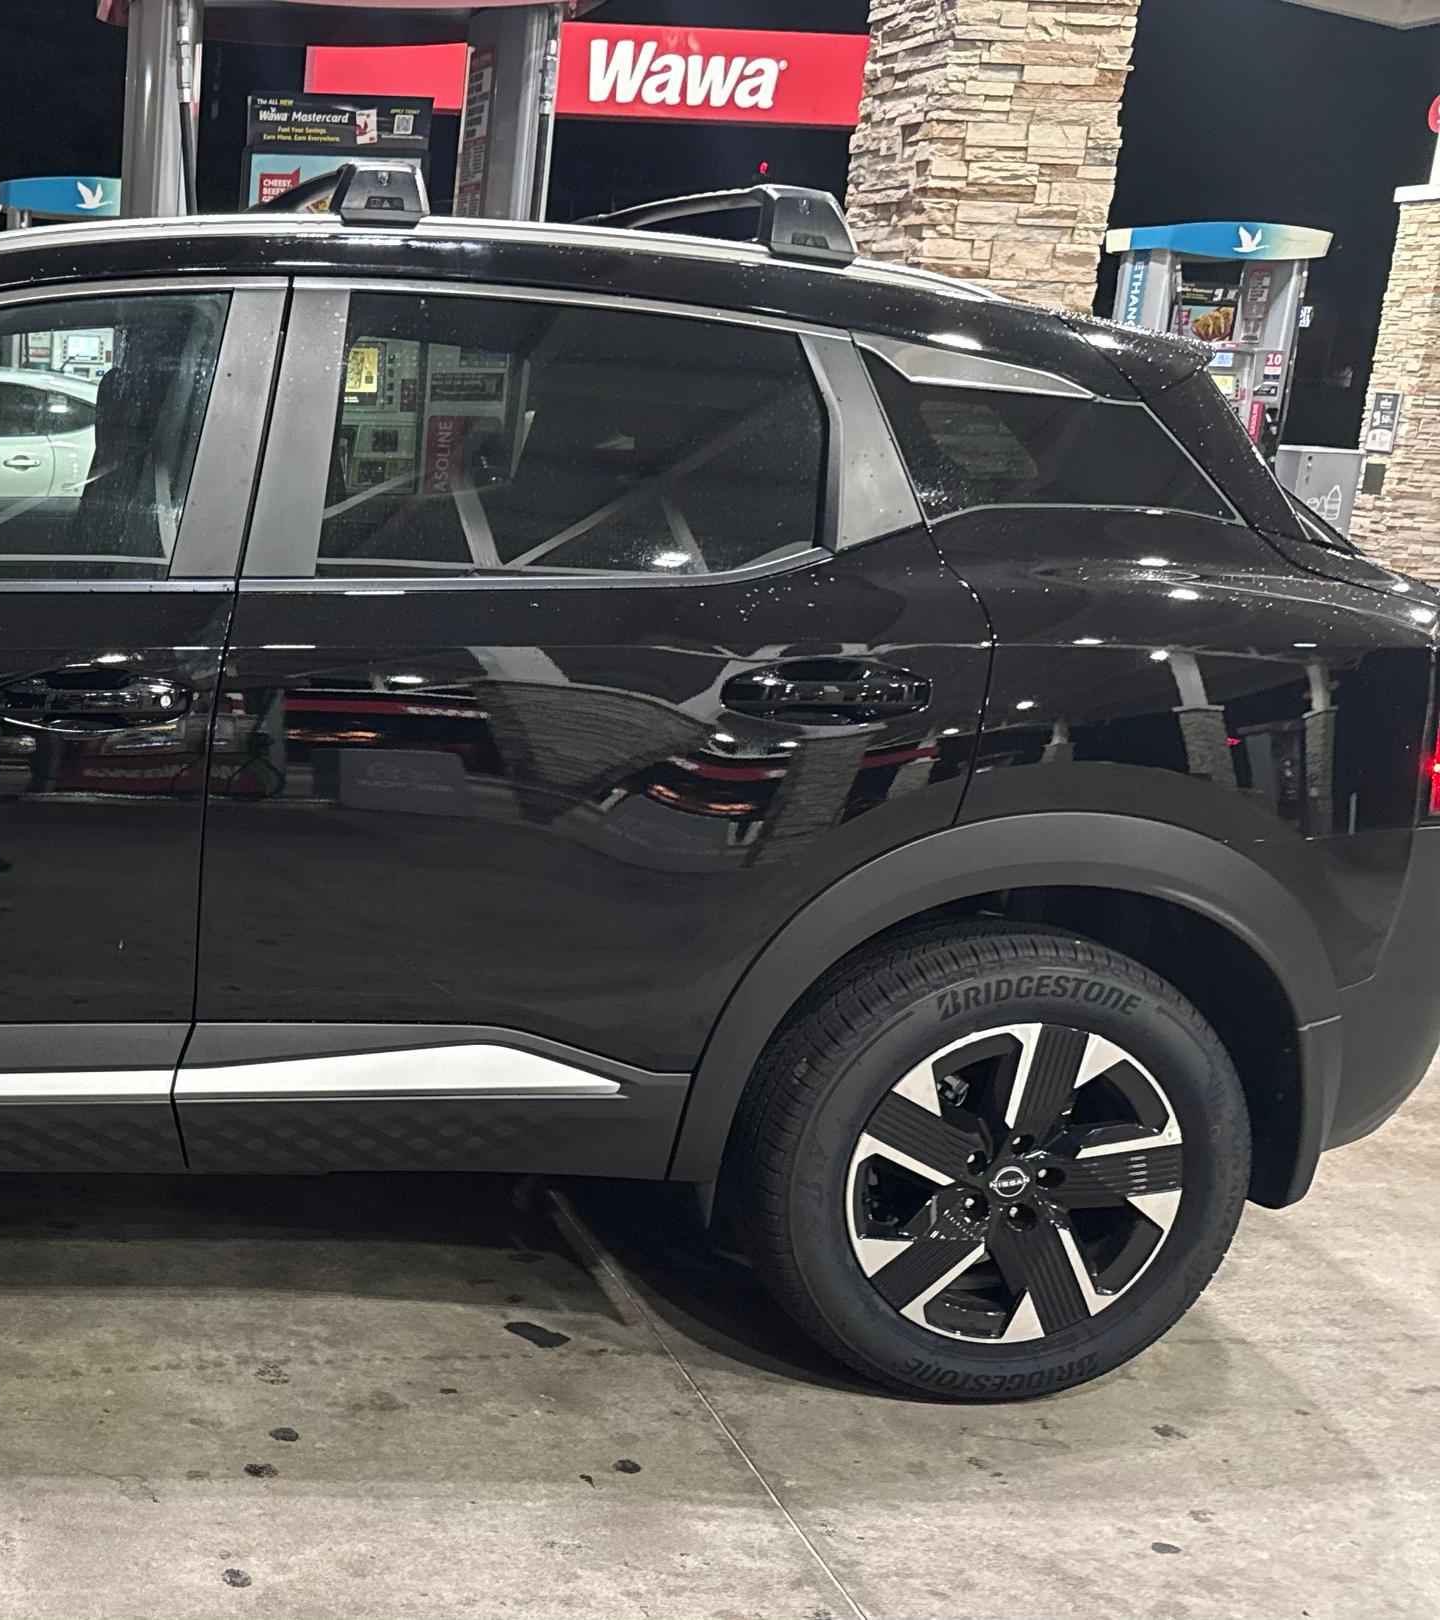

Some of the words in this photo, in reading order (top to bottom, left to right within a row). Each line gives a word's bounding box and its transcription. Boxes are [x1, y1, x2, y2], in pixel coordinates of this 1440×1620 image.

[589, 39, 779, 109] Wawa
[268, 98, 279, 106] ALL
[259, 109, 288, 121] Wawa
[291, 111, 349, 124] Mastercard
[263, 133, 276, 141] Earn
[1266, 353, 1282, 366] 10
[433, 421, 453, 491] ASOLINE
[937, 974, 1142, 1021] BRIDGESTONE
[989, 1176, 1030, 1189] NISSAN
[900, 1355, 1098, 1394] BRIDGESTONE
